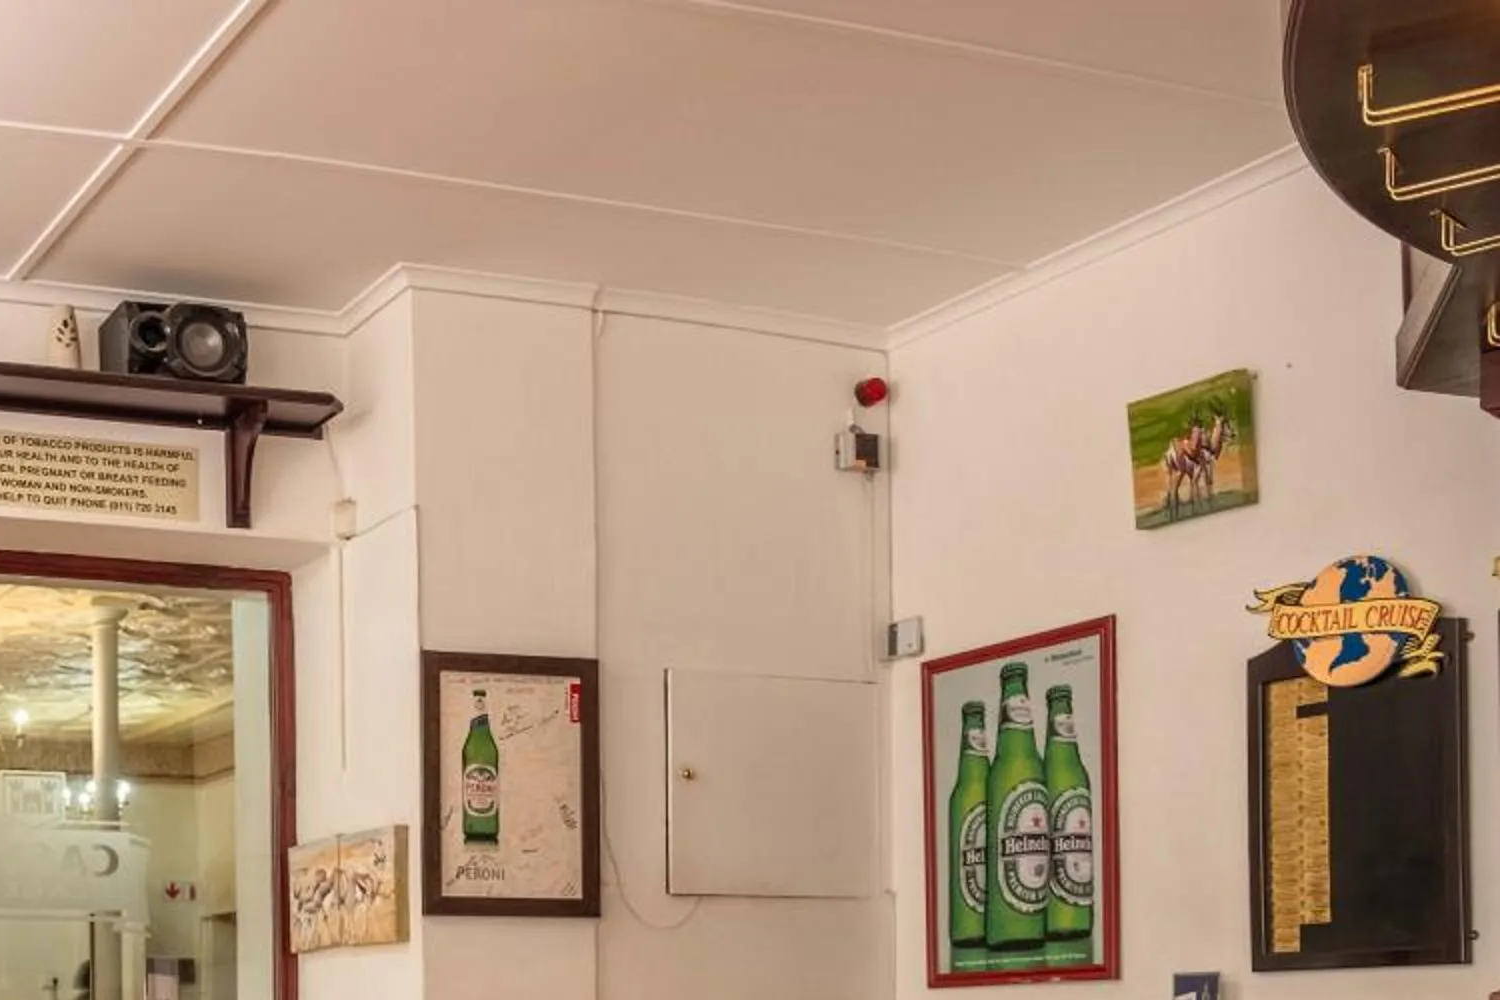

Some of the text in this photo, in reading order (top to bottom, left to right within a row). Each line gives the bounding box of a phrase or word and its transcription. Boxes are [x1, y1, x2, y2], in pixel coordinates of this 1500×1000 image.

[3, 435, 17, 445] OF
[20, 436, 72, 449] TOBACCO
[73, 441, 131, 455] PRODUCTS
[133, 447, 143, 456] IS
[145, 447, 193, 461] HARMFUL
[16, 450, 56, 462] HEALTH
[59, 453, 82, 464] AND
[84, 456, 98, 466] TO
[102, 458, 121, 468] THE
[123, 459, 164, 471] HEALTH
[166, 463, 181, 473] OF
[0, 478, 42, 489] WOMAN
[44, 481, 67, 491] AND
[20, 465, 77, 479] PREGNANT
[79, 470, 95, 480] OR
[97, 472, 140, 484] BREAST
[141, 475, 187, 488] FEEDING
[26, 493, 41, 503] TO
[43, 495, 68, 505] QUIT
[70, 498, 106, 509] PHONE
[1277, 602, 1429, 635] COCKTAIL CRUISE
[455, 864, 506, 881] PERONI
